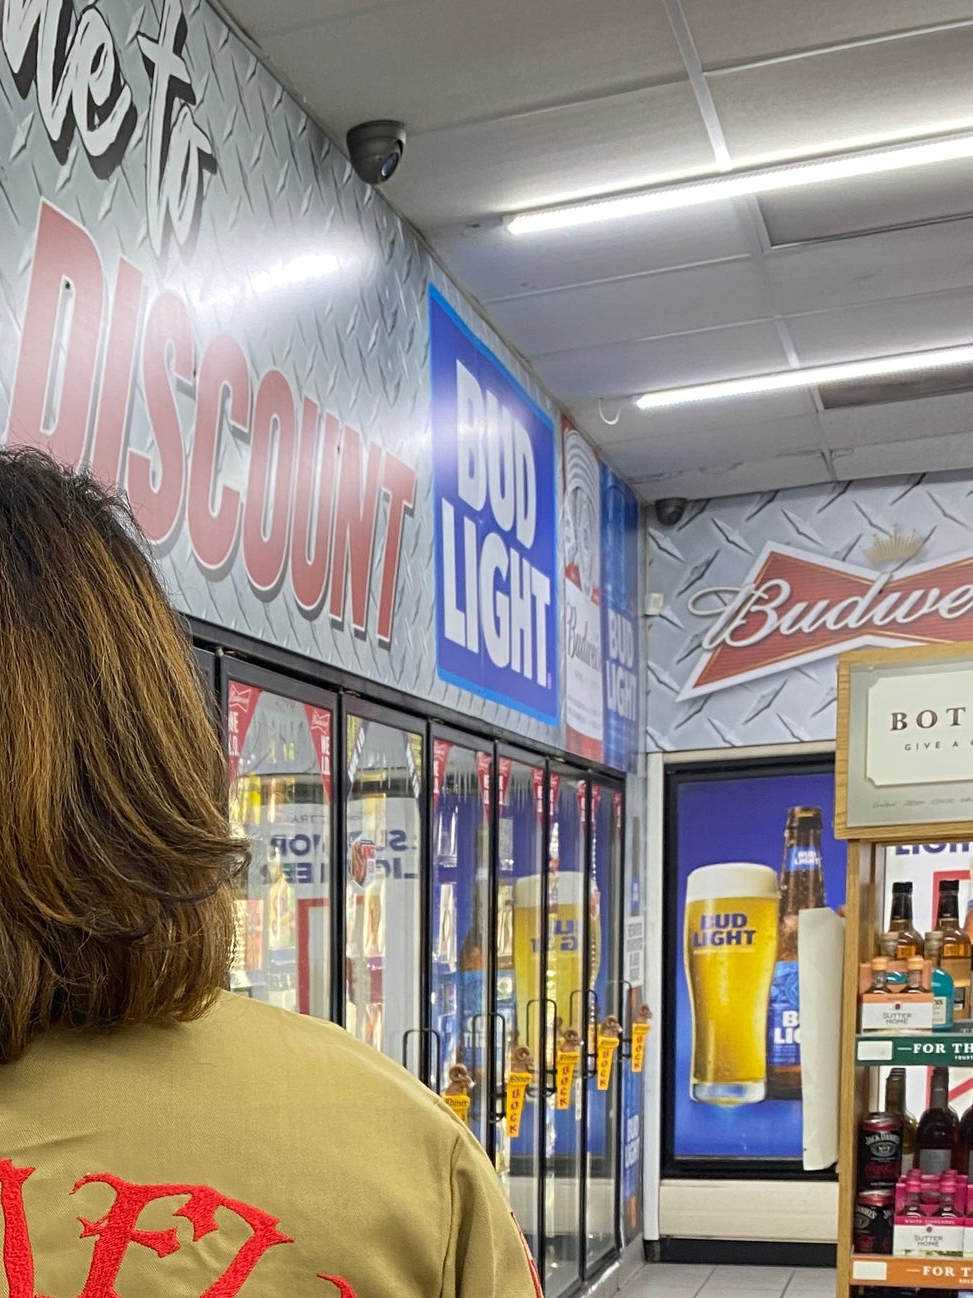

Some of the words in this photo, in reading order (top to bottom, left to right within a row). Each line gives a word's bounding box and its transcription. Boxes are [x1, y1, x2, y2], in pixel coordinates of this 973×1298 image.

[7, 197, 416, 643] DISCOUNT
[455, 358, 537, 550] BUD
[441, 498, 551, 688] LIGHT
[890, 706, 967, 732] BOT
[904, 741, 941, 751] GIVE
[952, 740, 959, 748] A
[700, 913, 748, 930] BUD
[692, 929, 756, 948] LIGHT
[913, 1043, 946, 1054] FOR
[559, 1065, 569, 1106] BOCK
[509, 1088, 520, 1134] BOCK
[922, 1265, 955, 1277] FOR
